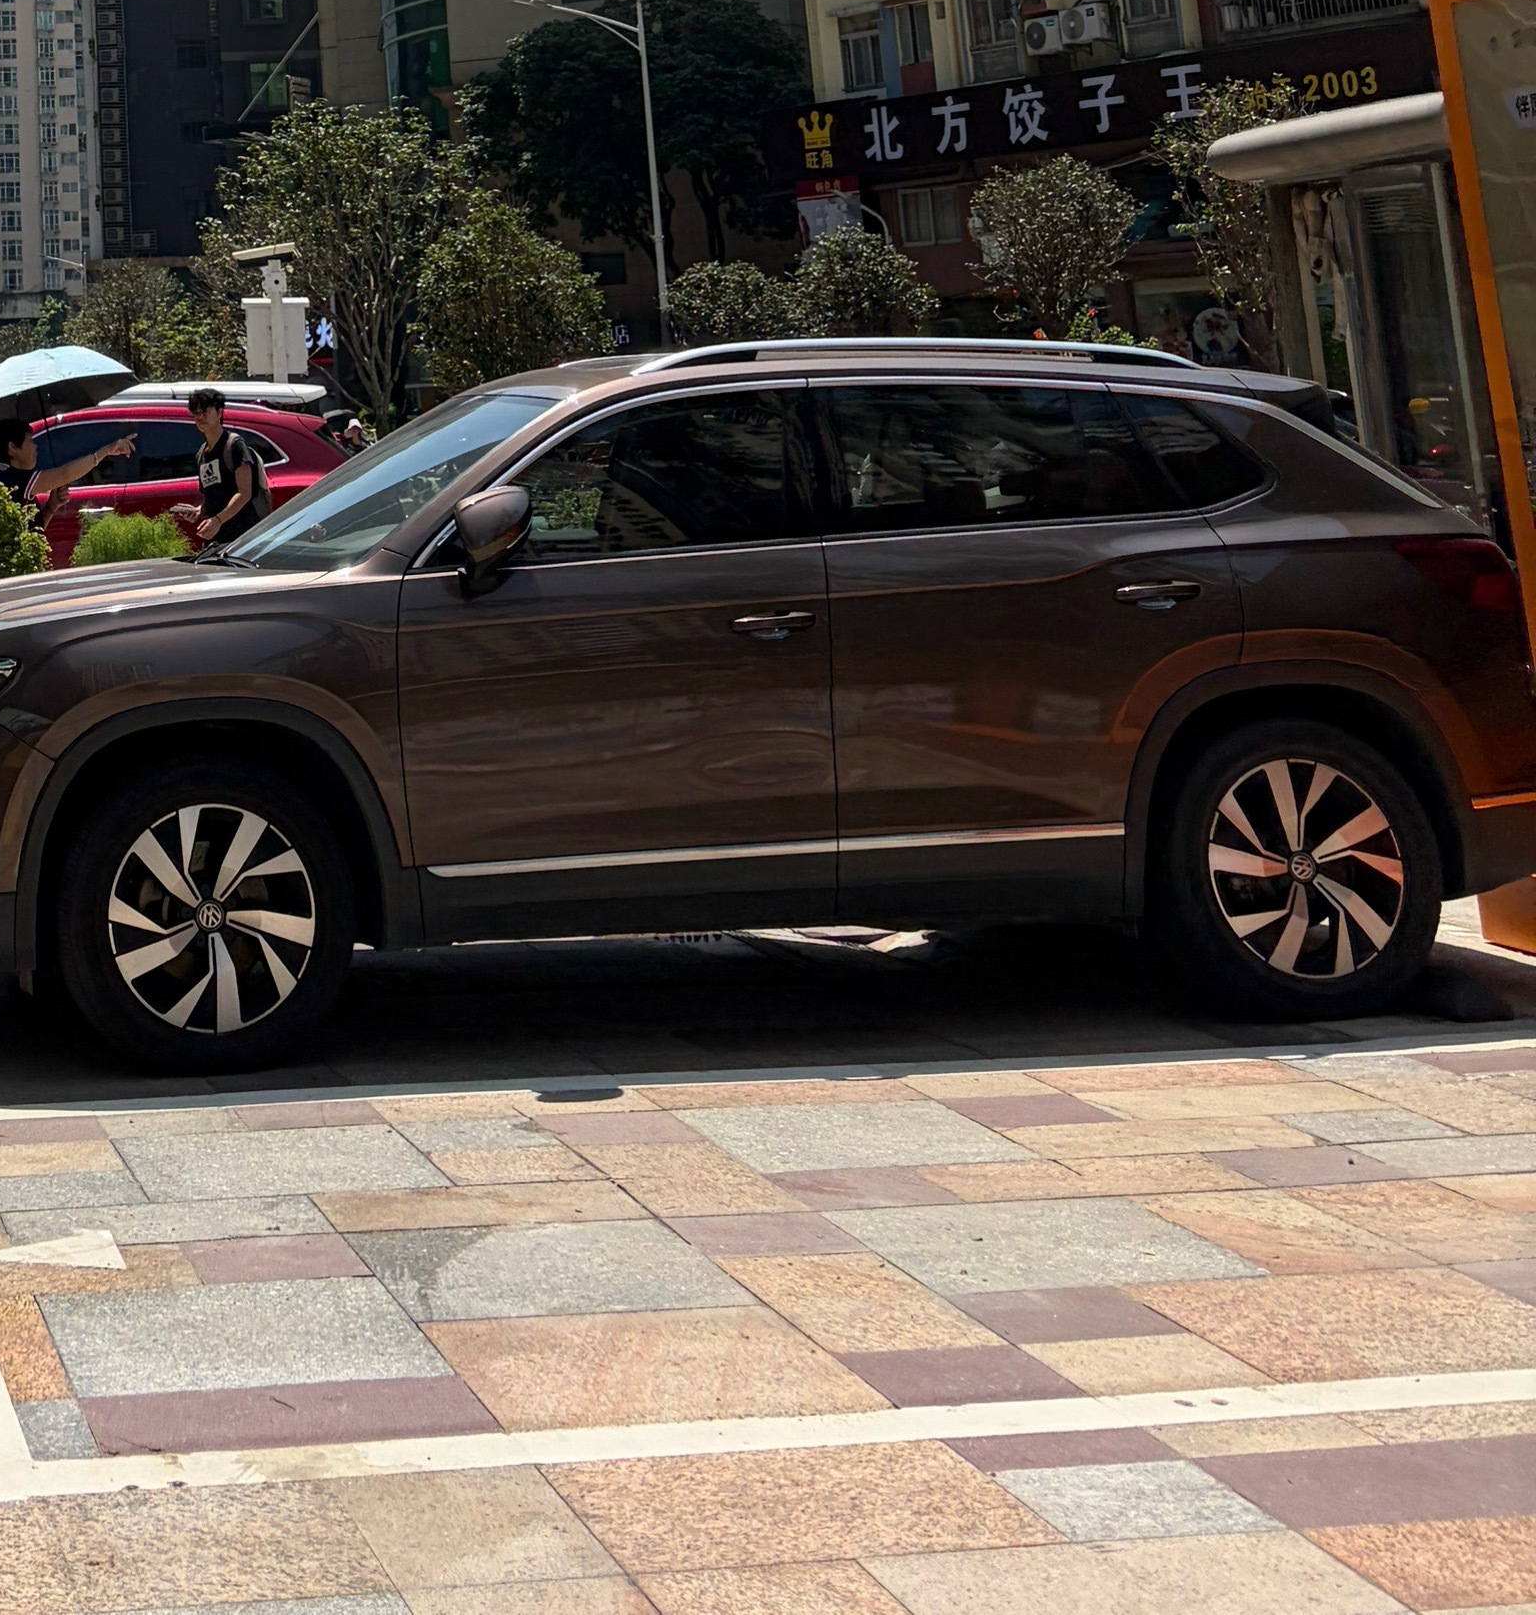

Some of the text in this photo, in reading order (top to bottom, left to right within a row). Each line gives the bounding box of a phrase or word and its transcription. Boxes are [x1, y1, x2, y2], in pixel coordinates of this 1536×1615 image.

[1303, 66, 1378, 102] 2003
[863, 64, 1205, 162] 北方饺子王
[805, 150, 833, 168] 旺角
